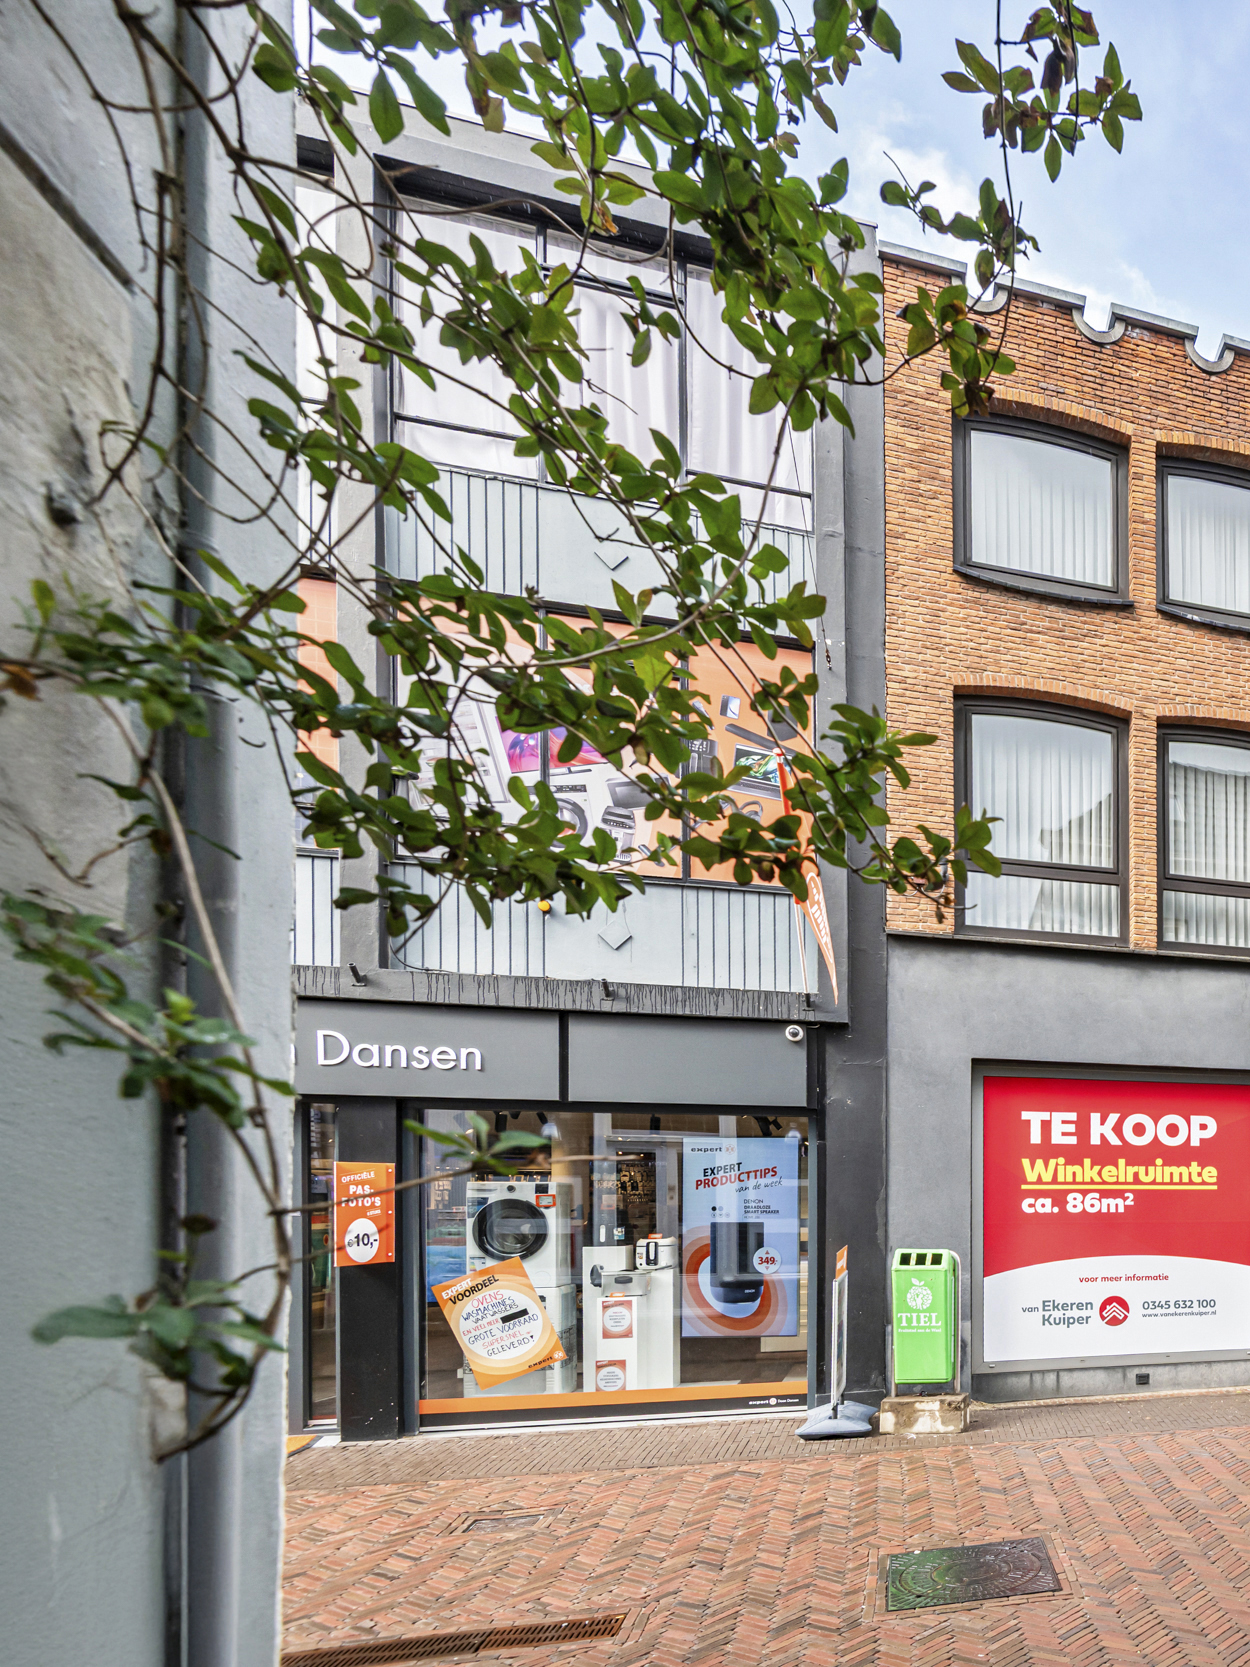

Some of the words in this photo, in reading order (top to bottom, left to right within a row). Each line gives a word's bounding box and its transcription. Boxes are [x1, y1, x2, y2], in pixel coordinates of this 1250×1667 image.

[316, 1029, 482, 1071] Dansen
[1021, 1111, 1077, 1144] TE
[1090, 1112, 1218, 1147] KOOP
[341, 1170, 375, 1183] OFFICIËLE
[695, 1166, 778, 1190] PRODUCTTIPS
[703, 1162, 742, 1177] EXPERT
[1021, 1157, 1218, 1183] Winkelruimte
[349, 1184, 374, 1195] PAS-
[752, 1180, 762, 1191] de
[763, 1176, 783, 1188] week
[341, 1197, 381, 1207] FOTO'S
[1021, 1196, 1059, 1214] ca.
[1079, 1275, 1099, 1283] voor
[1124, 1273, 1169, 1282] informatie
[441, 1278, 473, 1300] EXPERT
[448, 1274, 500, 1305] VOORDEEL
[471, 1290, 504, 1309] OVENS
[1021, 1305, 1039, 1313] van
[1041, 1300, 1094, 1312] Ekeren
[1142, 1300, 1171, 1311] 0345
[1173, 1299, 1194, 1309] 632
[1196, 1299, 1216, 1309] 100
[461, 1296, 515, 1322] WASMACHINES
[897, 1312, 942, 1327] TIEL
[1041, 1313, 1092, 1328] Kuiper
[1141, 1309, 1217, 1318] www.vanekerenkuiper.nl
[468, 1328, 497, 1345] GROTE
[496, 1313, 539, 1334] VOORRAAD
[527, 1355, 553, 1369] expert
